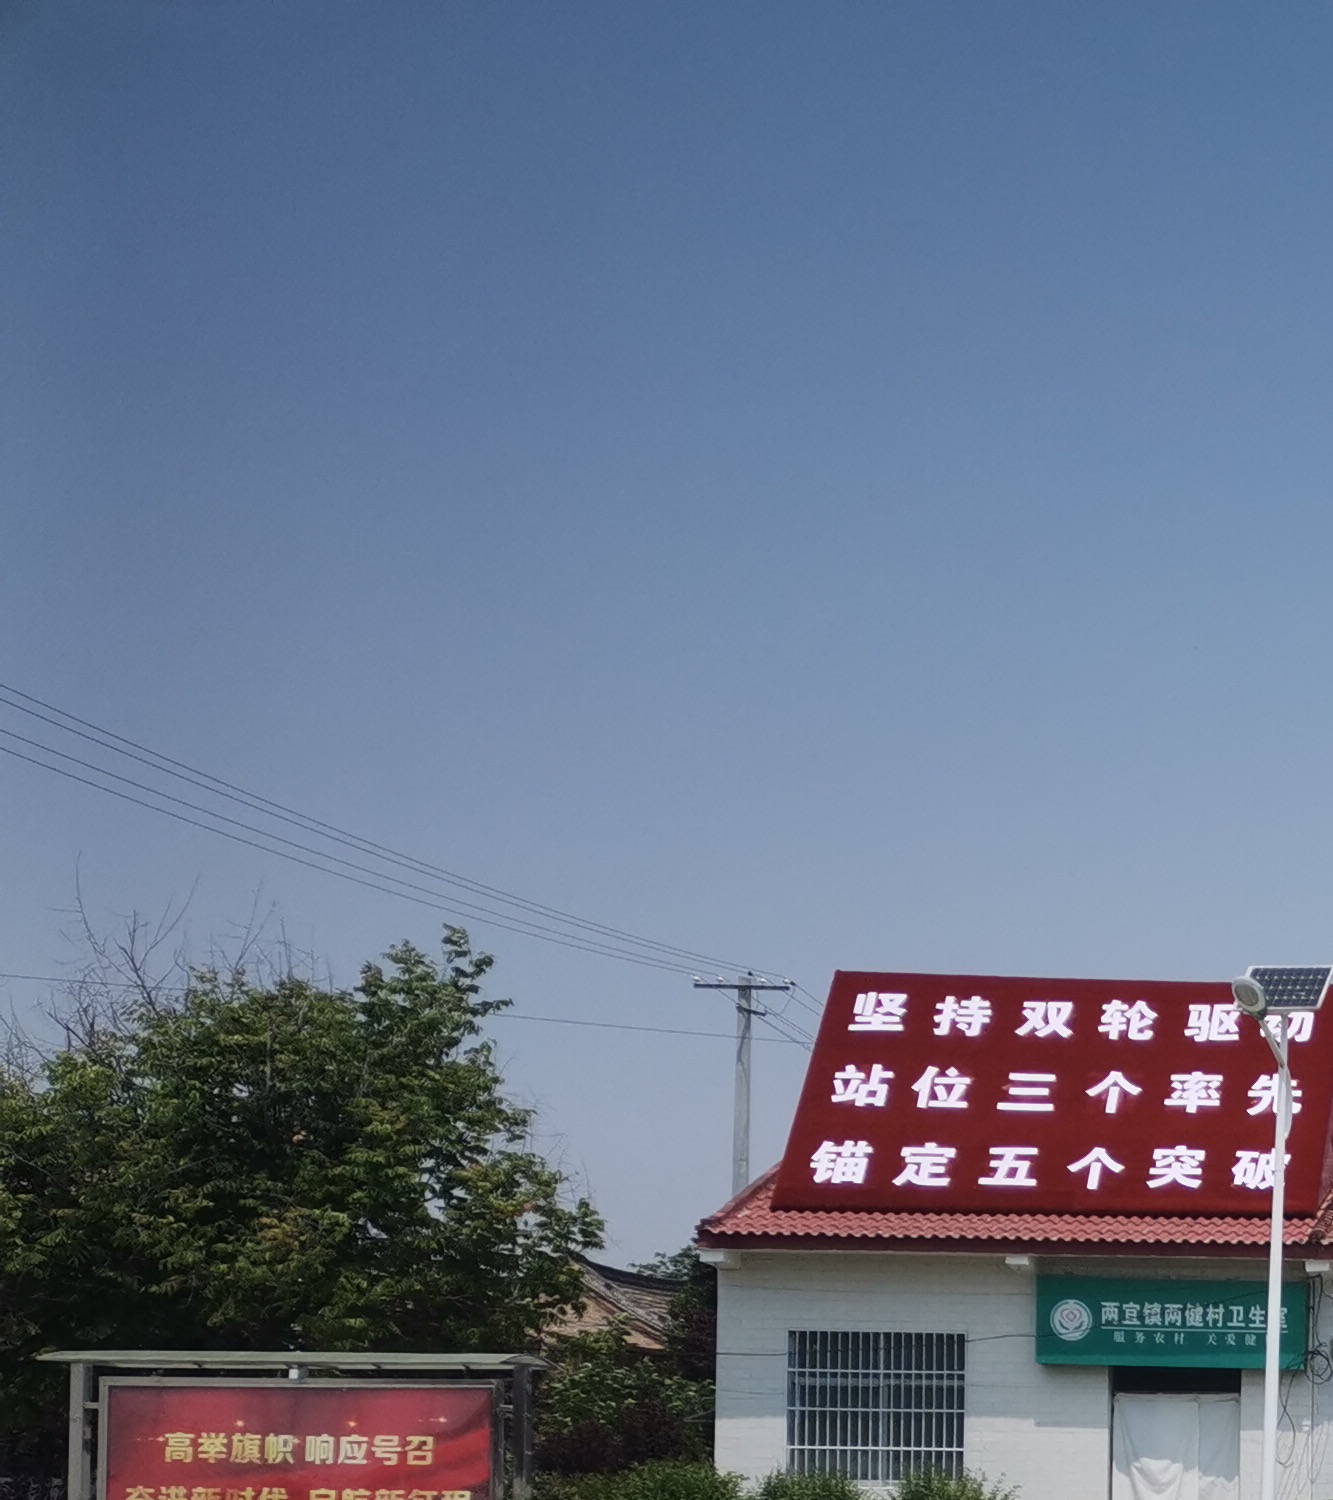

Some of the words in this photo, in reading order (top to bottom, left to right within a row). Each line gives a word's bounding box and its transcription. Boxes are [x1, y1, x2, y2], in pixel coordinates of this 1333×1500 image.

[848, 991, 1315, 1043] 坚持双轮驱动
[830, 1063, 1303, 1116] 站位三个率先
[809, 1140, 1292, 1190] 锚定五个突破
[1206, 1332, 1268, 1347] 关爱健
[163, 1432, 295, 1464] 高举旗帜
[304, 1433, 435, 1467] 响应号召
